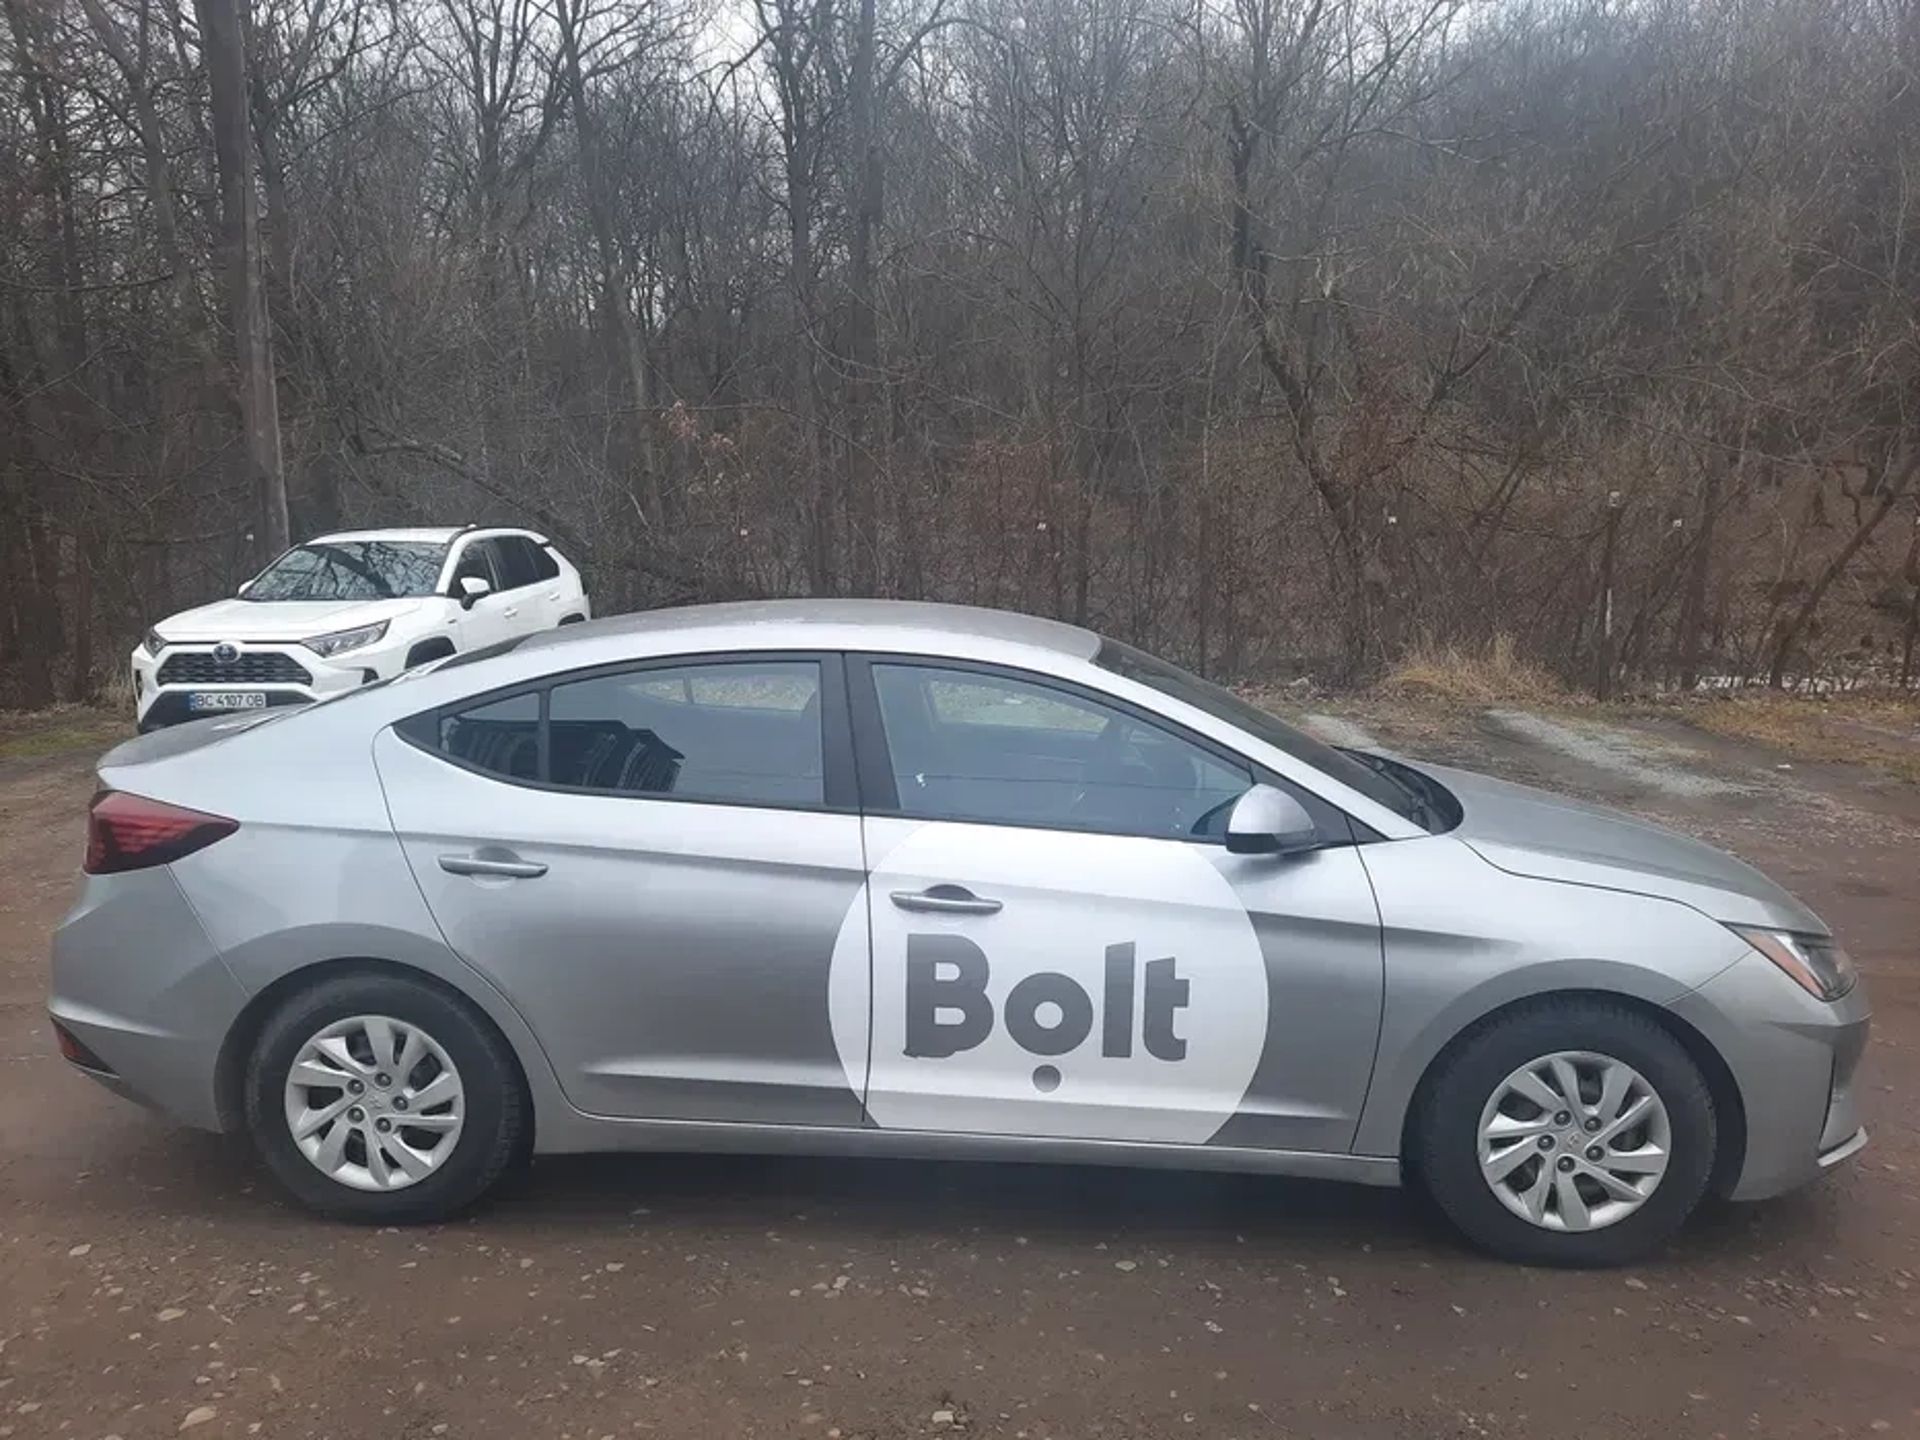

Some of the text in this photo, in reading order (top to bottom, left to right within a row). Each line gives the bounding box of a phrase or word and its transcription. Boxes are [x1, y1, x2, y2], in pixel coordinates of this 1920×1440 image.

[196, 694, 214, 707] BC
[216, 694, 244, 707] 4107
[902, 932, 1190, 1093] Bolt
